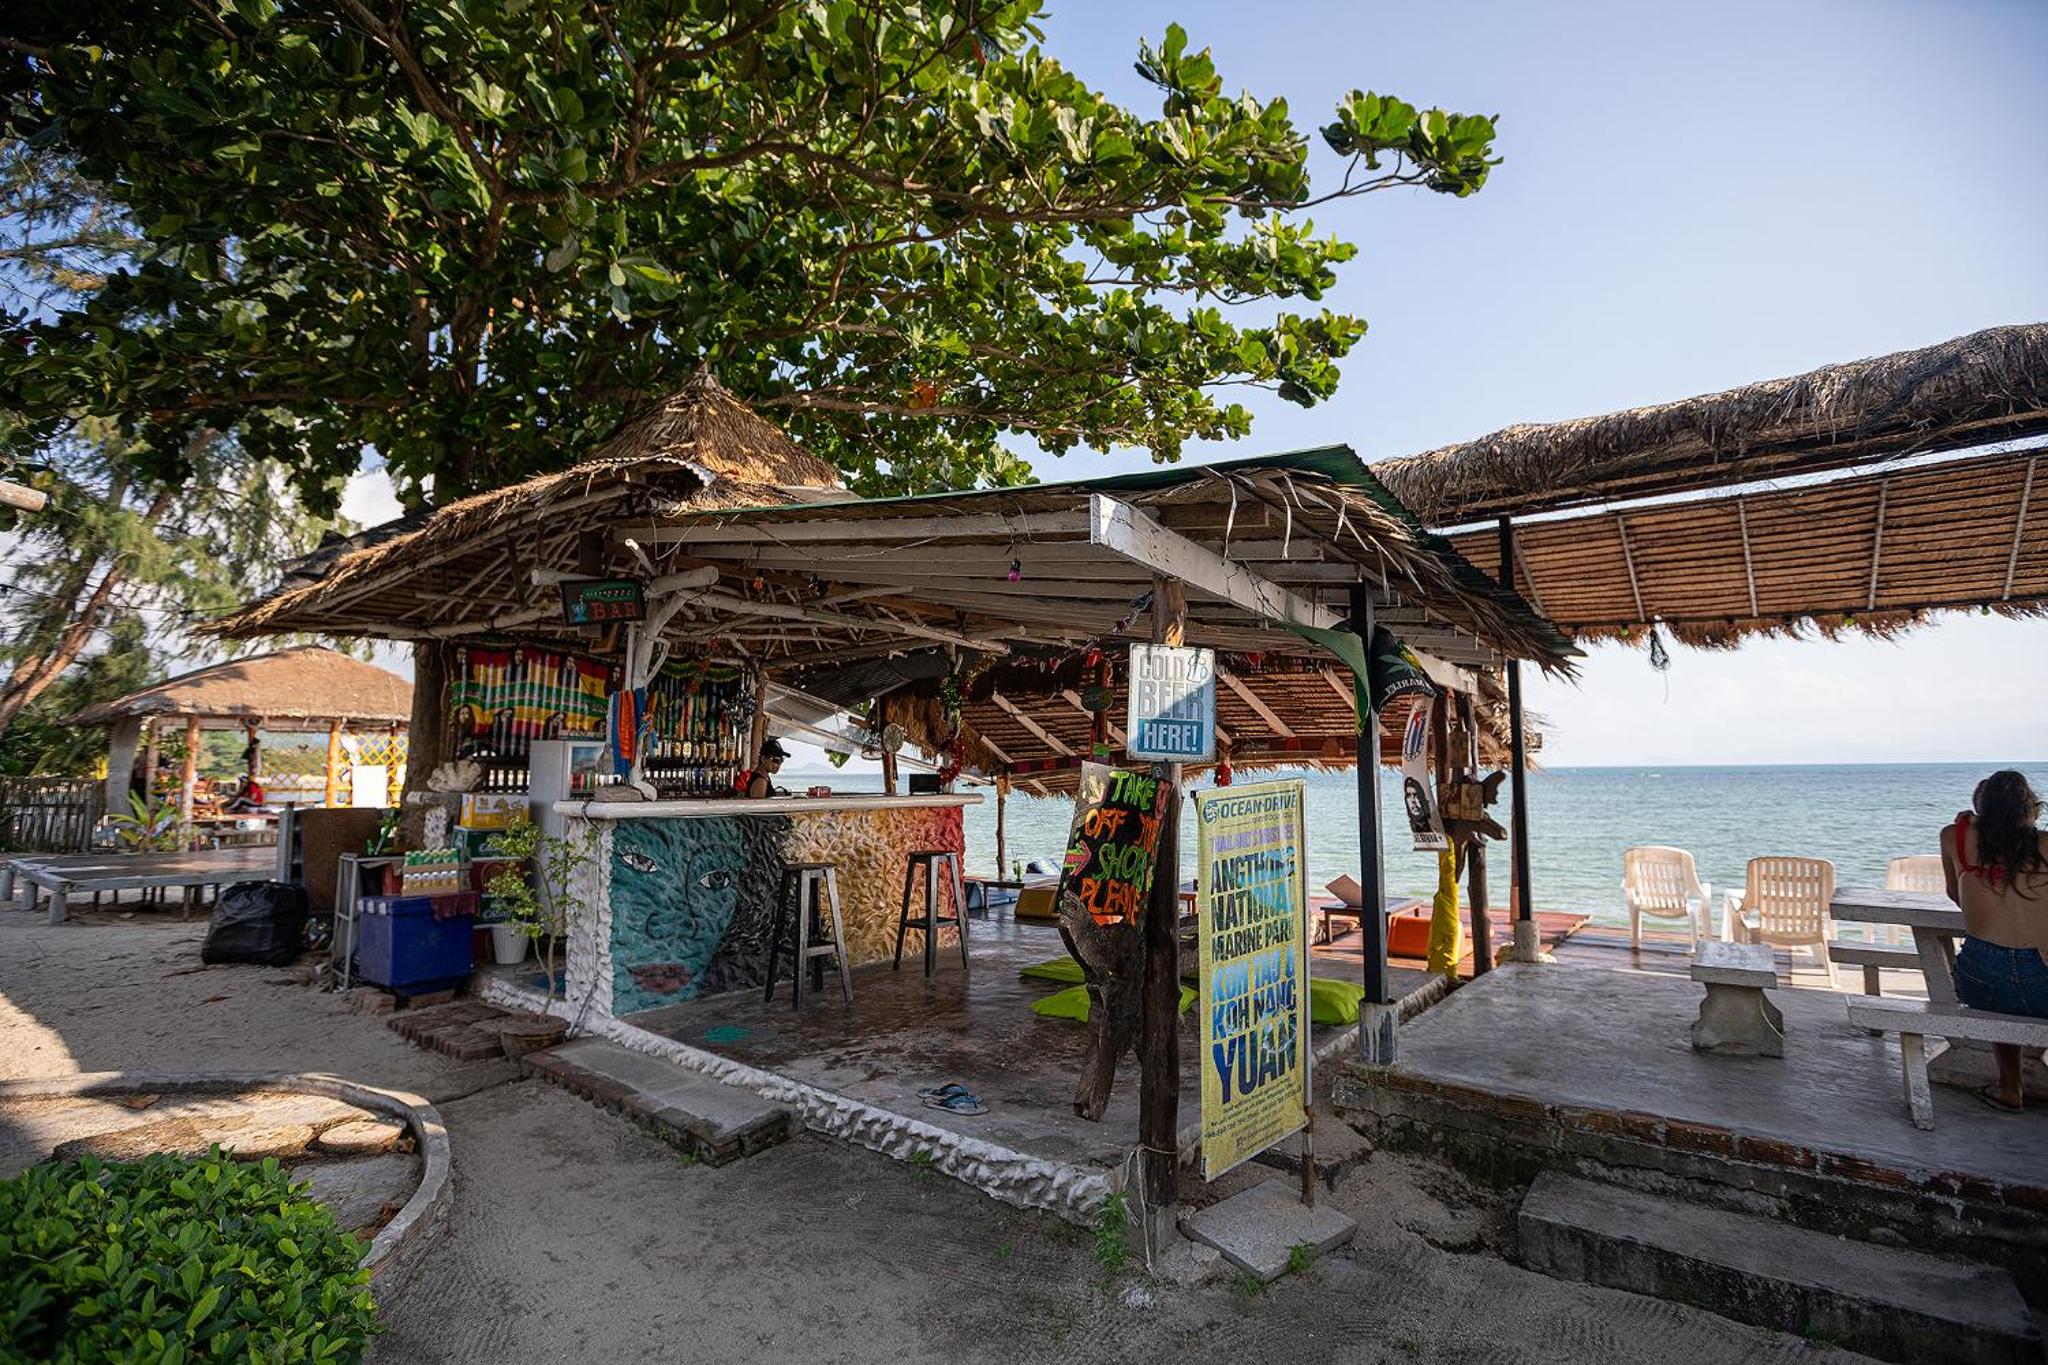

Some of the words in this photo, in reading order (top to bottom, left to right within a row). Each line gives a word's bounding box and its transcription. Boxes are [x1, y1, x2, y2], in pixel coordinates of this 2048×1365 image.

[1139, 654, 1184, 680] COLD
[1139, 680, 1204, 719] BEER
[1143, 723, 1197, 752] HERE!
[1109, 770, 1156, 810] TAKE
[1221, 798, 1261, 819] OCEAN
[1084, 808, 1128, 841] OFF
[1211, 846, 1295, 896] ANGTHONG
[1211, 880, 1294, 935] NATIONAL
[1211, 926, 1263, 965] MARINE
[1212, 960, 1249, 1005] KOH
[1253, 950, 1281, 991] TAO
[1212, 996, 1249, 1041] KOH
[1253, 978, 1296, 1028] NANG
[1212, 1013, 1297, 1105] YUAN
